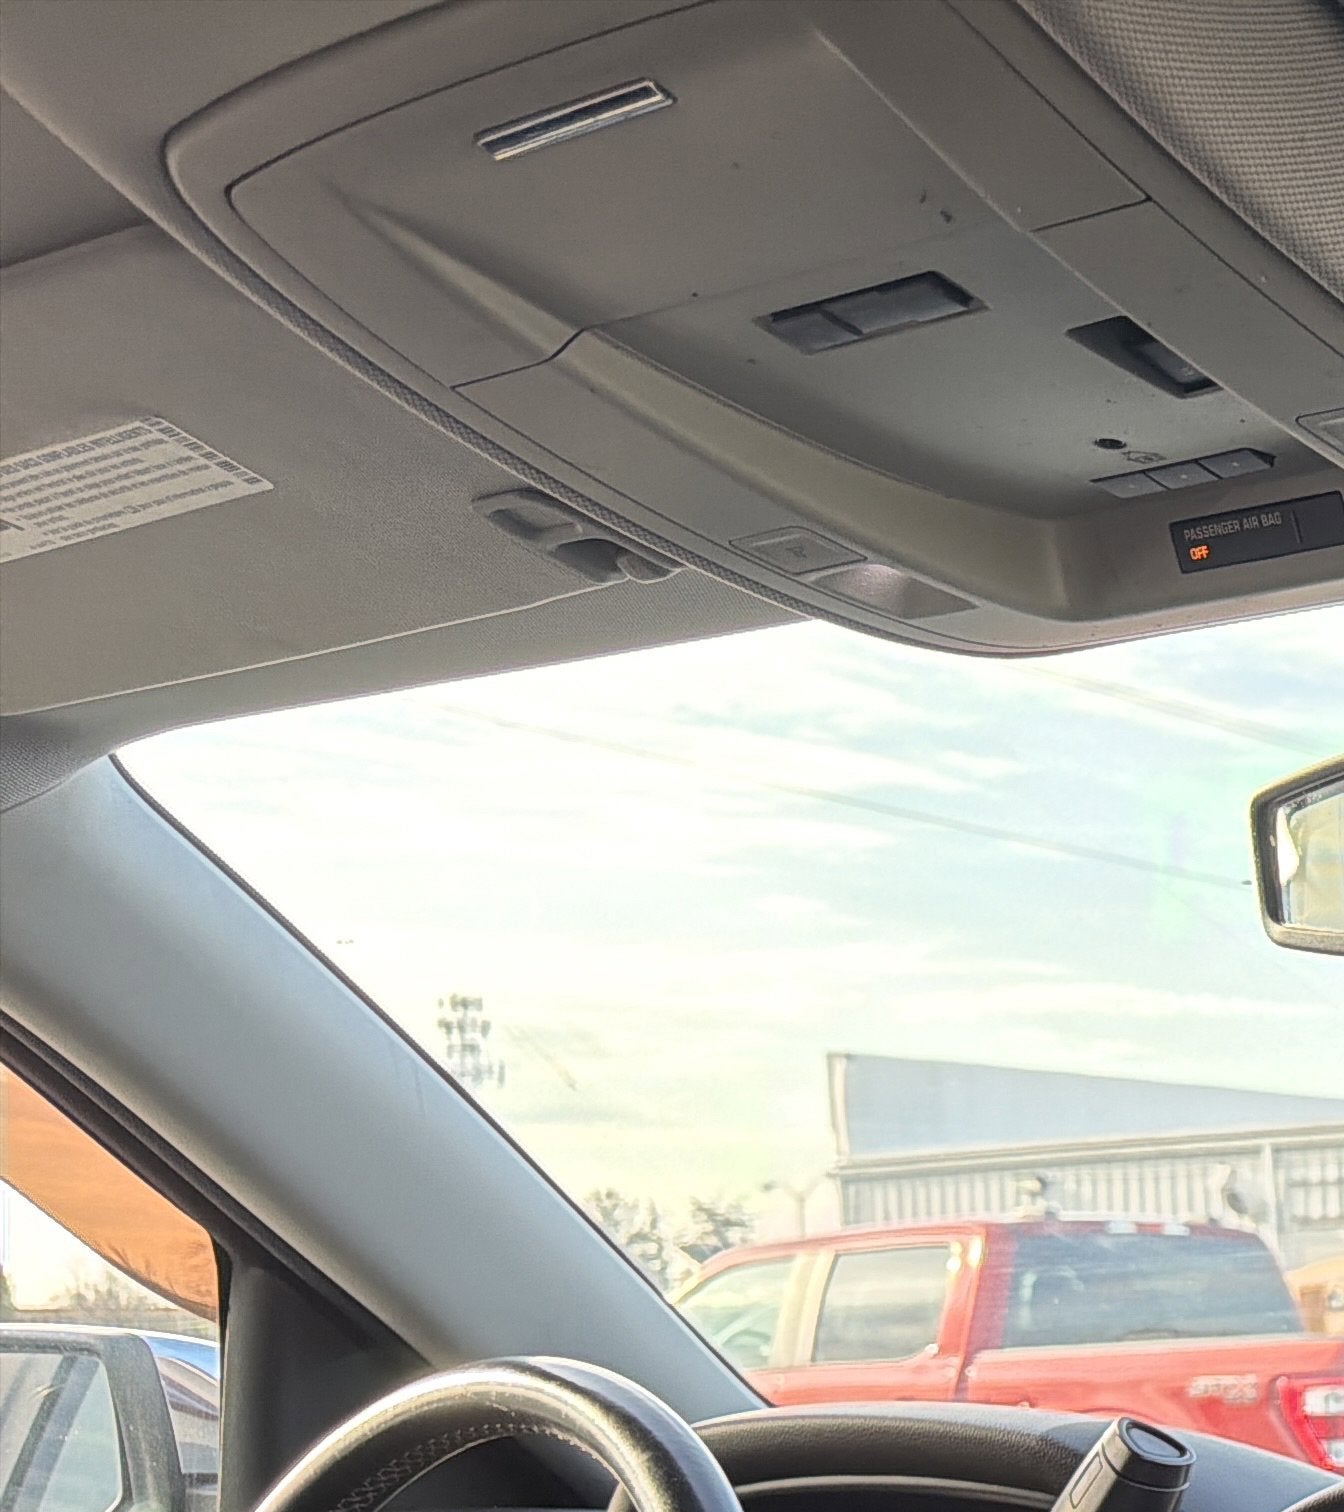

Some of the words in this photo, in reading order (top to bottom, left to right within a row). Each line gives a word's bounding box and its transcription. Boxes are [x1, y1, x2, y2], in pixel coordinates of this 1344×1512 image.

[1183, 522, 1241, 542] PASSENGER
[1242, 516, 1260, 531] AIR
[1261, 511, 1283, 528] BAG
[1189, 544, 1210, 561] OFF
